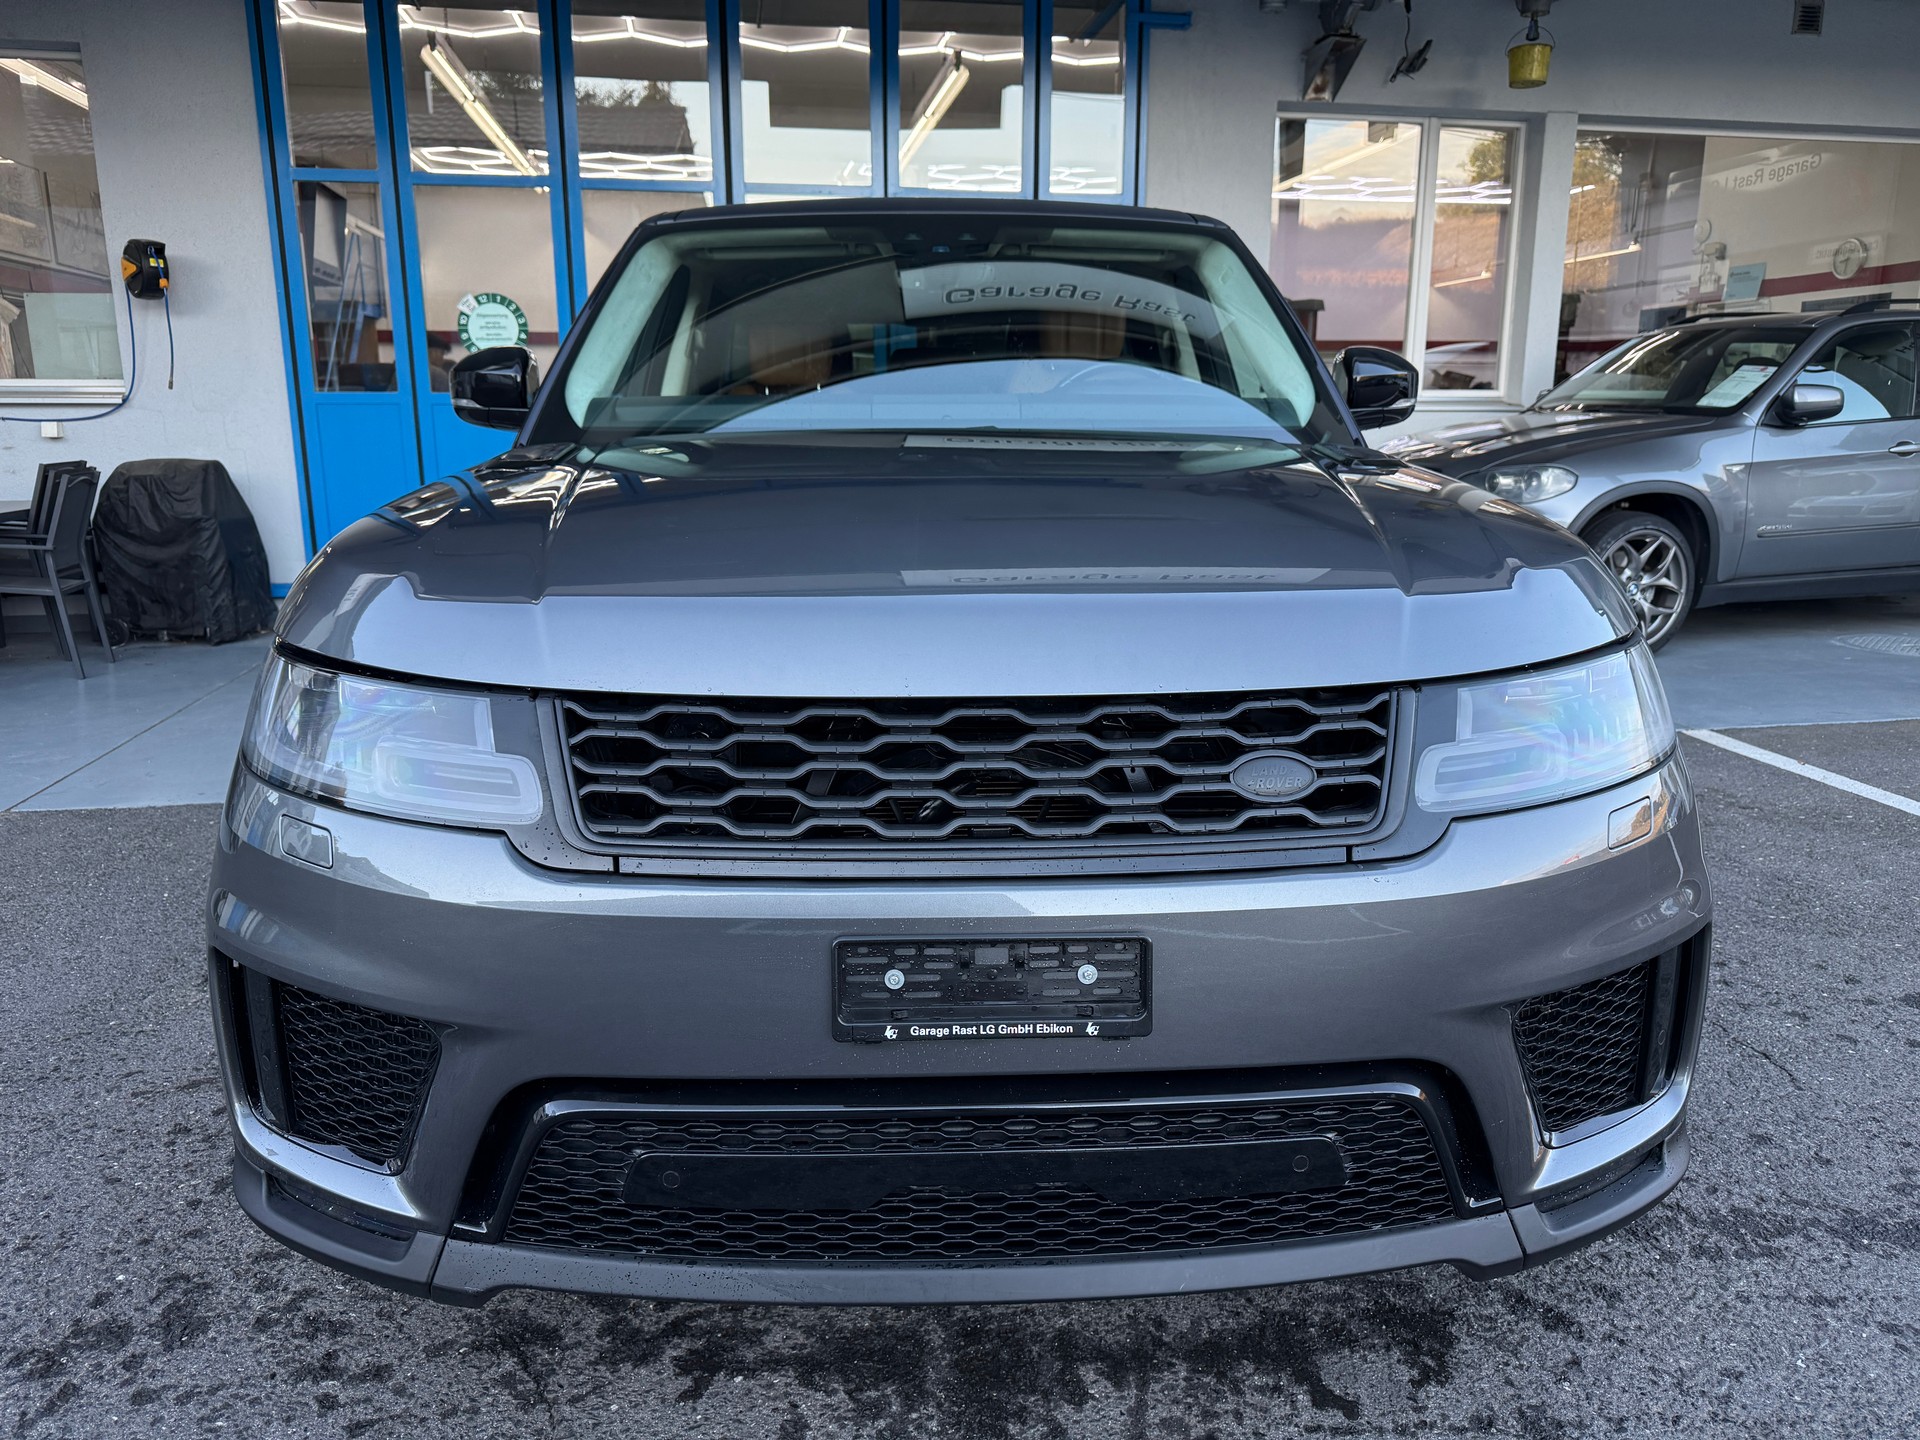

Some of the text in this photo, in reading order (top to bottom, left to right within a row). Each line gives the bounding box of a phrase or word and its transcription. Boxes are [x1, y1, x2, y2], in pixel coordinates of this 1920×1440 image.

[1251, 765, 1288, 777] LAND
[1256, 776, 1302, 789] ROVER
[910, 1025, 949, 1038] Garage
[952, 1025, 977, 1035] Rast
[980, 1025, 995, 1035] LG
[998, 1024, 1033, 1035] GmbH
[1036, 1023, 1073, 1034] Ebikon
